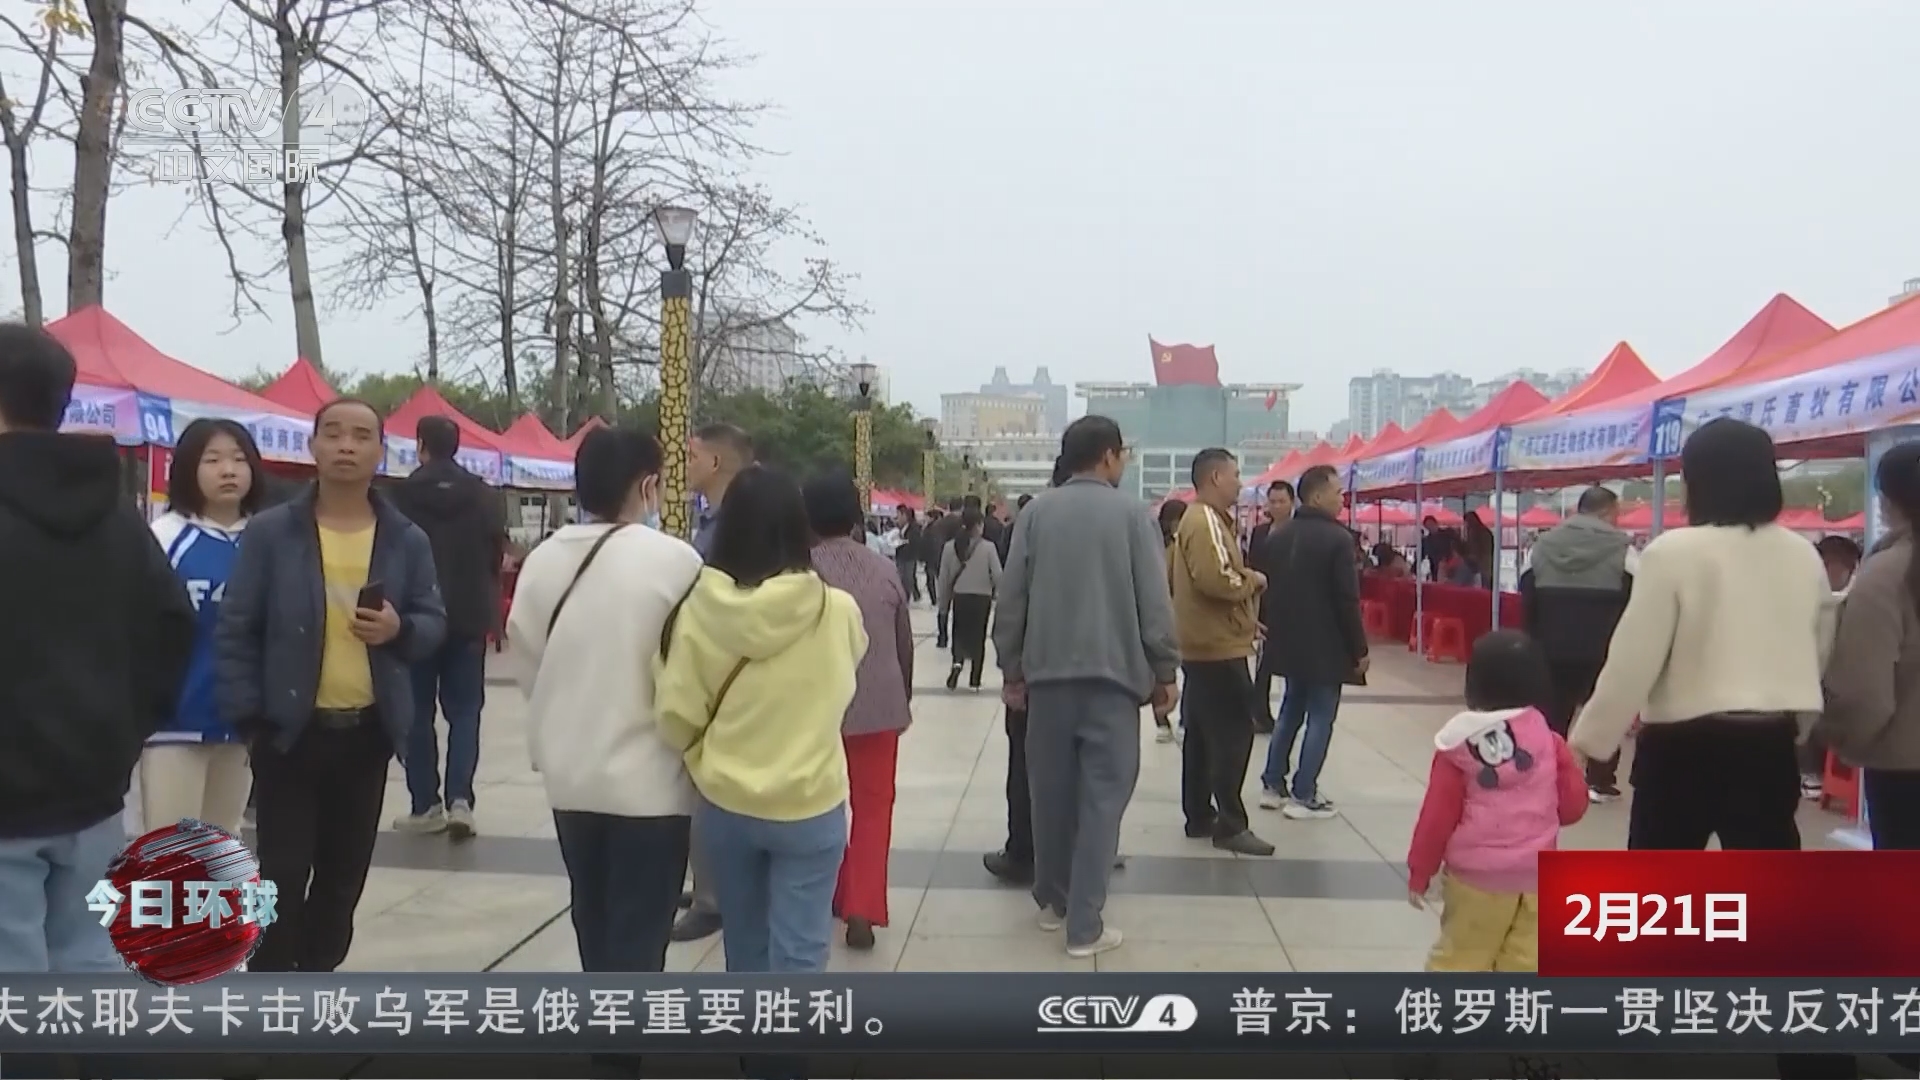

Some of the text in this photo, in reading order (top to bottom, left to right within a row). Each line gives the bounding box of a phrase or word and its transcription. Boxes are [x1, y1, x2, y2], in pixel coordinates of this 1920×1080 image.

[64, 398, 116, 428] 限公司
[144, 412, 170, 442] 94
[1655, 419, 1681, 455] 119
